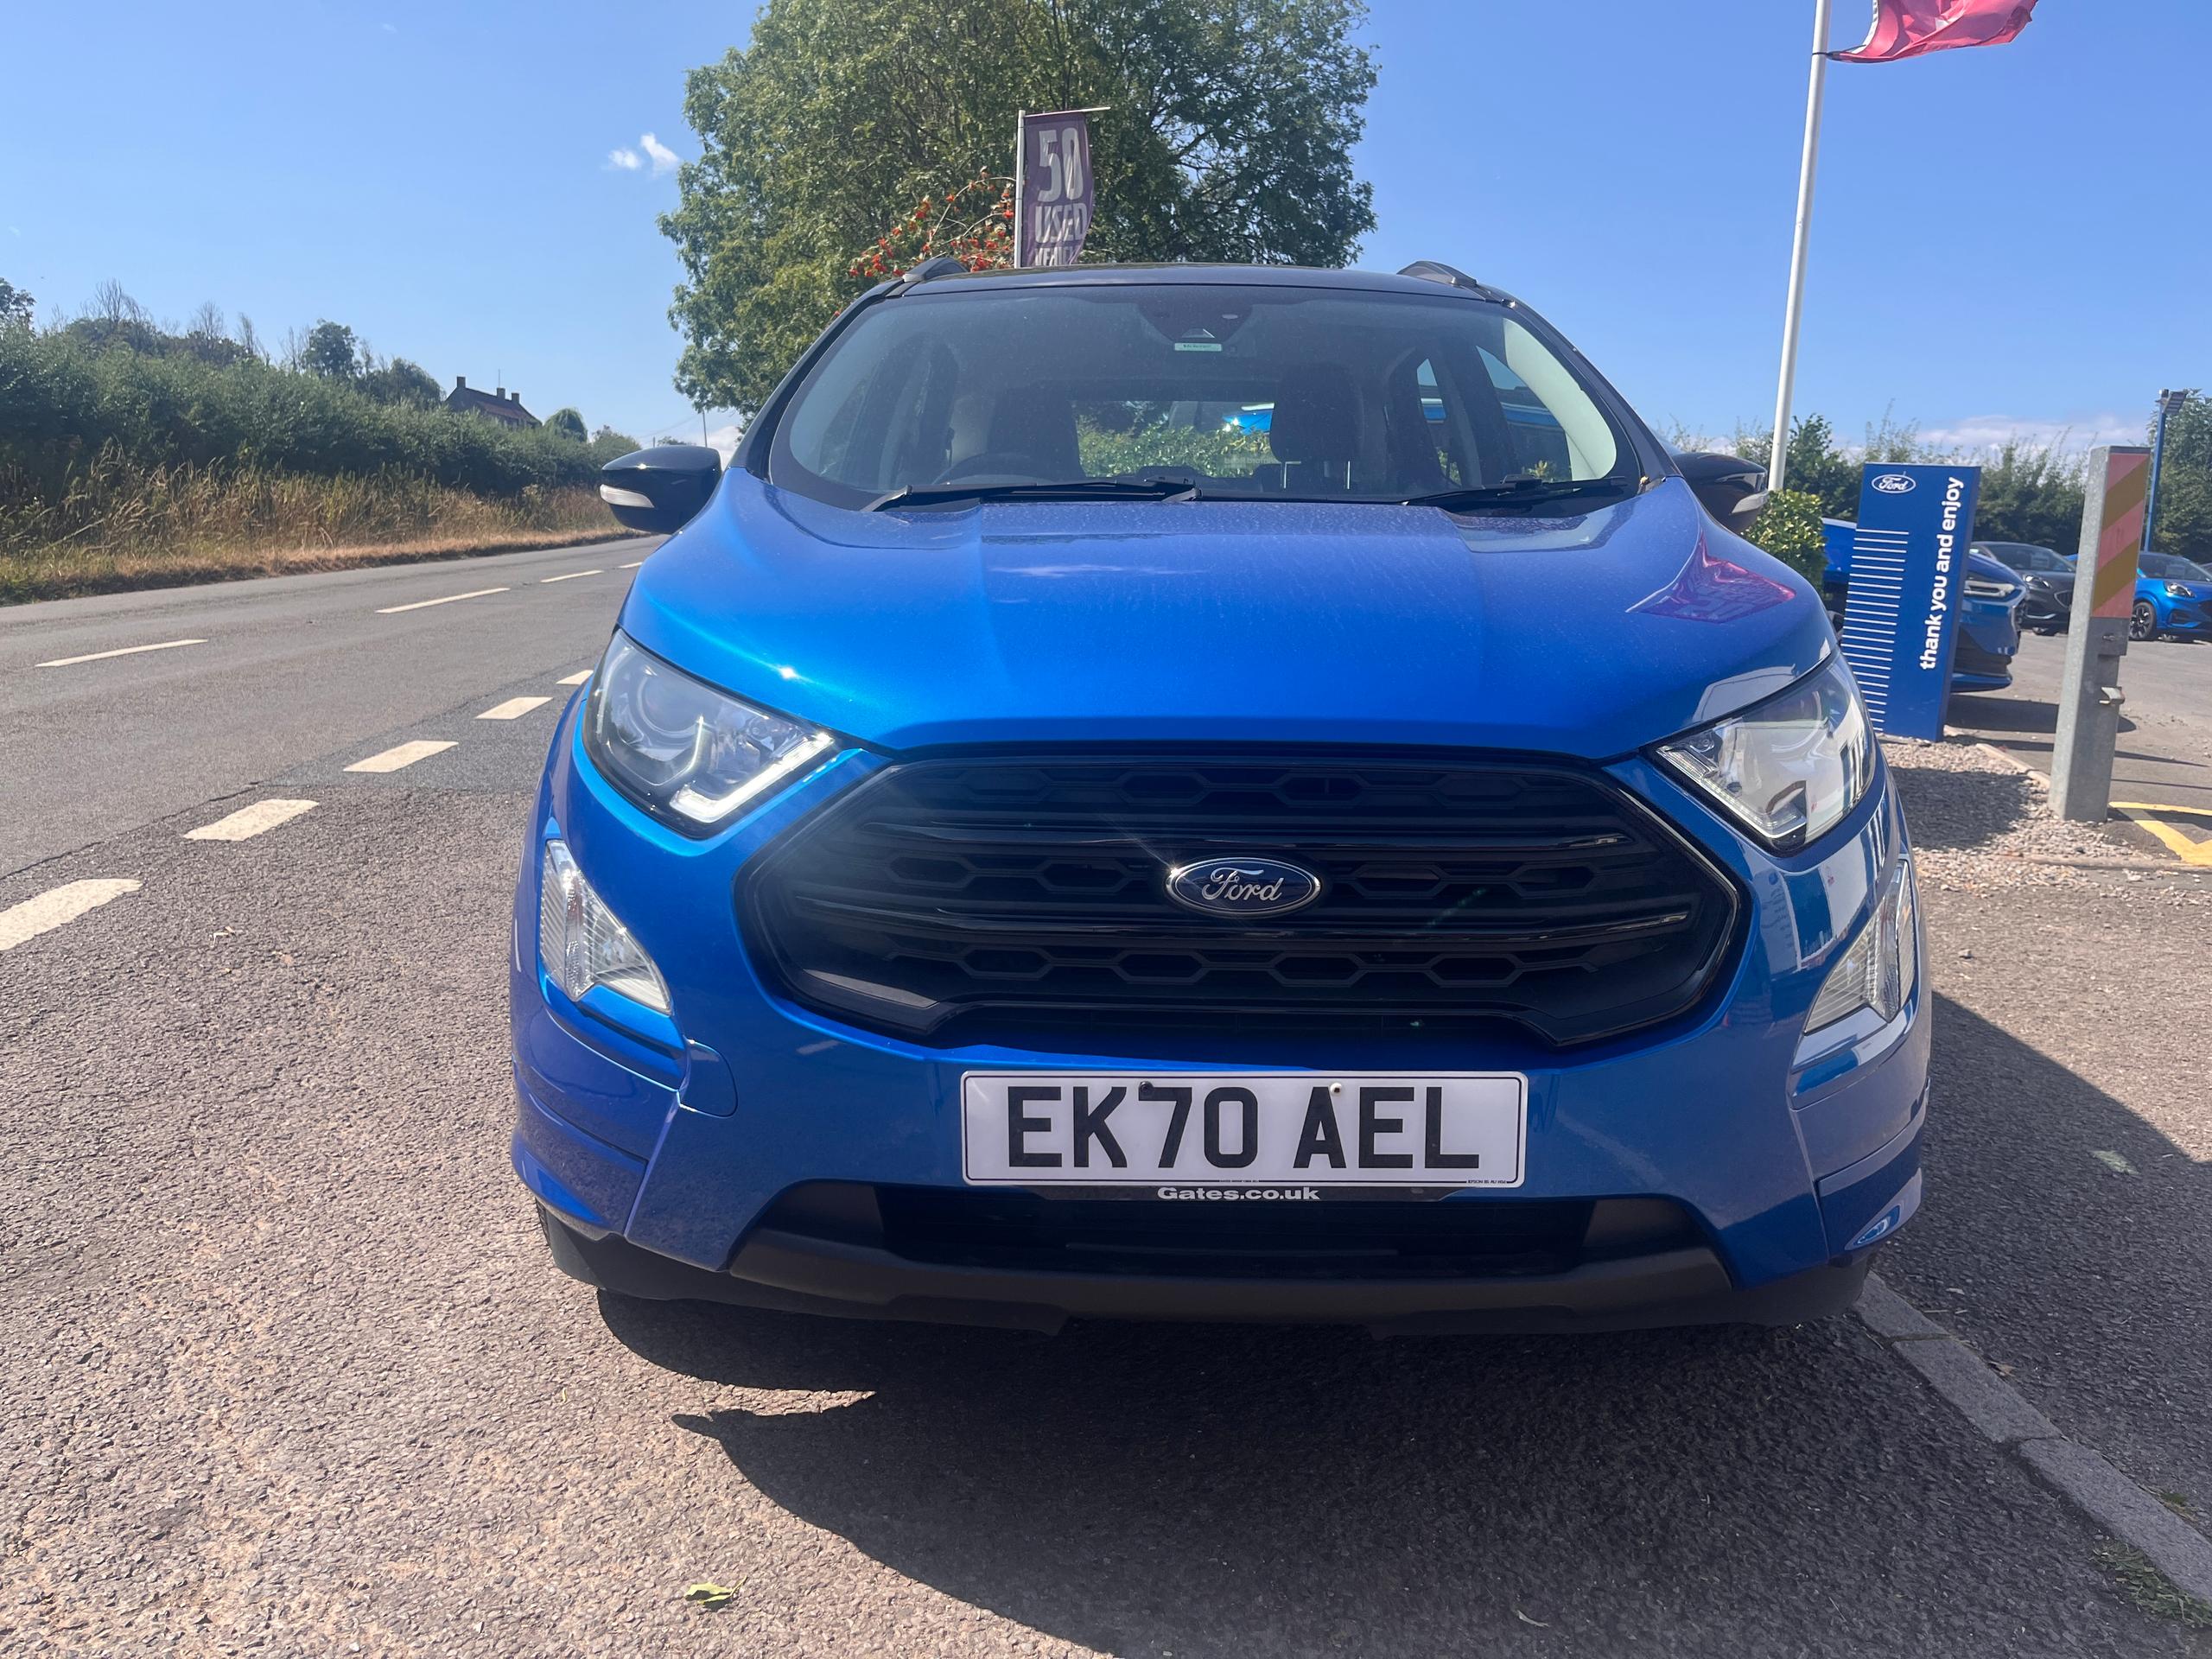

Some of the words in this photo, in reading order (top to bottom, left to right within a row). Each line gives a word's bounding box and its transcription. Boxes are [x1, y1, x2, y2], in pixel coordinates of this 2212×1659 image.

[1038, 127, 1084, 202] 50
[1035, 202, 1087, 244] USED
[1878, 476, 1909, 490] Ford
[1942, 477, 1964, 531] enjoy
[1936, 534, 1954, 573] and
[1930, 575, 1947, 611] you
[1920, 614, 1942, 671] thank
[1201, 867, 1285, 900] Ford
[1007, 1086, 1258, 1169] EK70
[1293, 1086, 1479, 1169] AEL
[1157, 1186, 1321, 1200] Gates.co.uk
